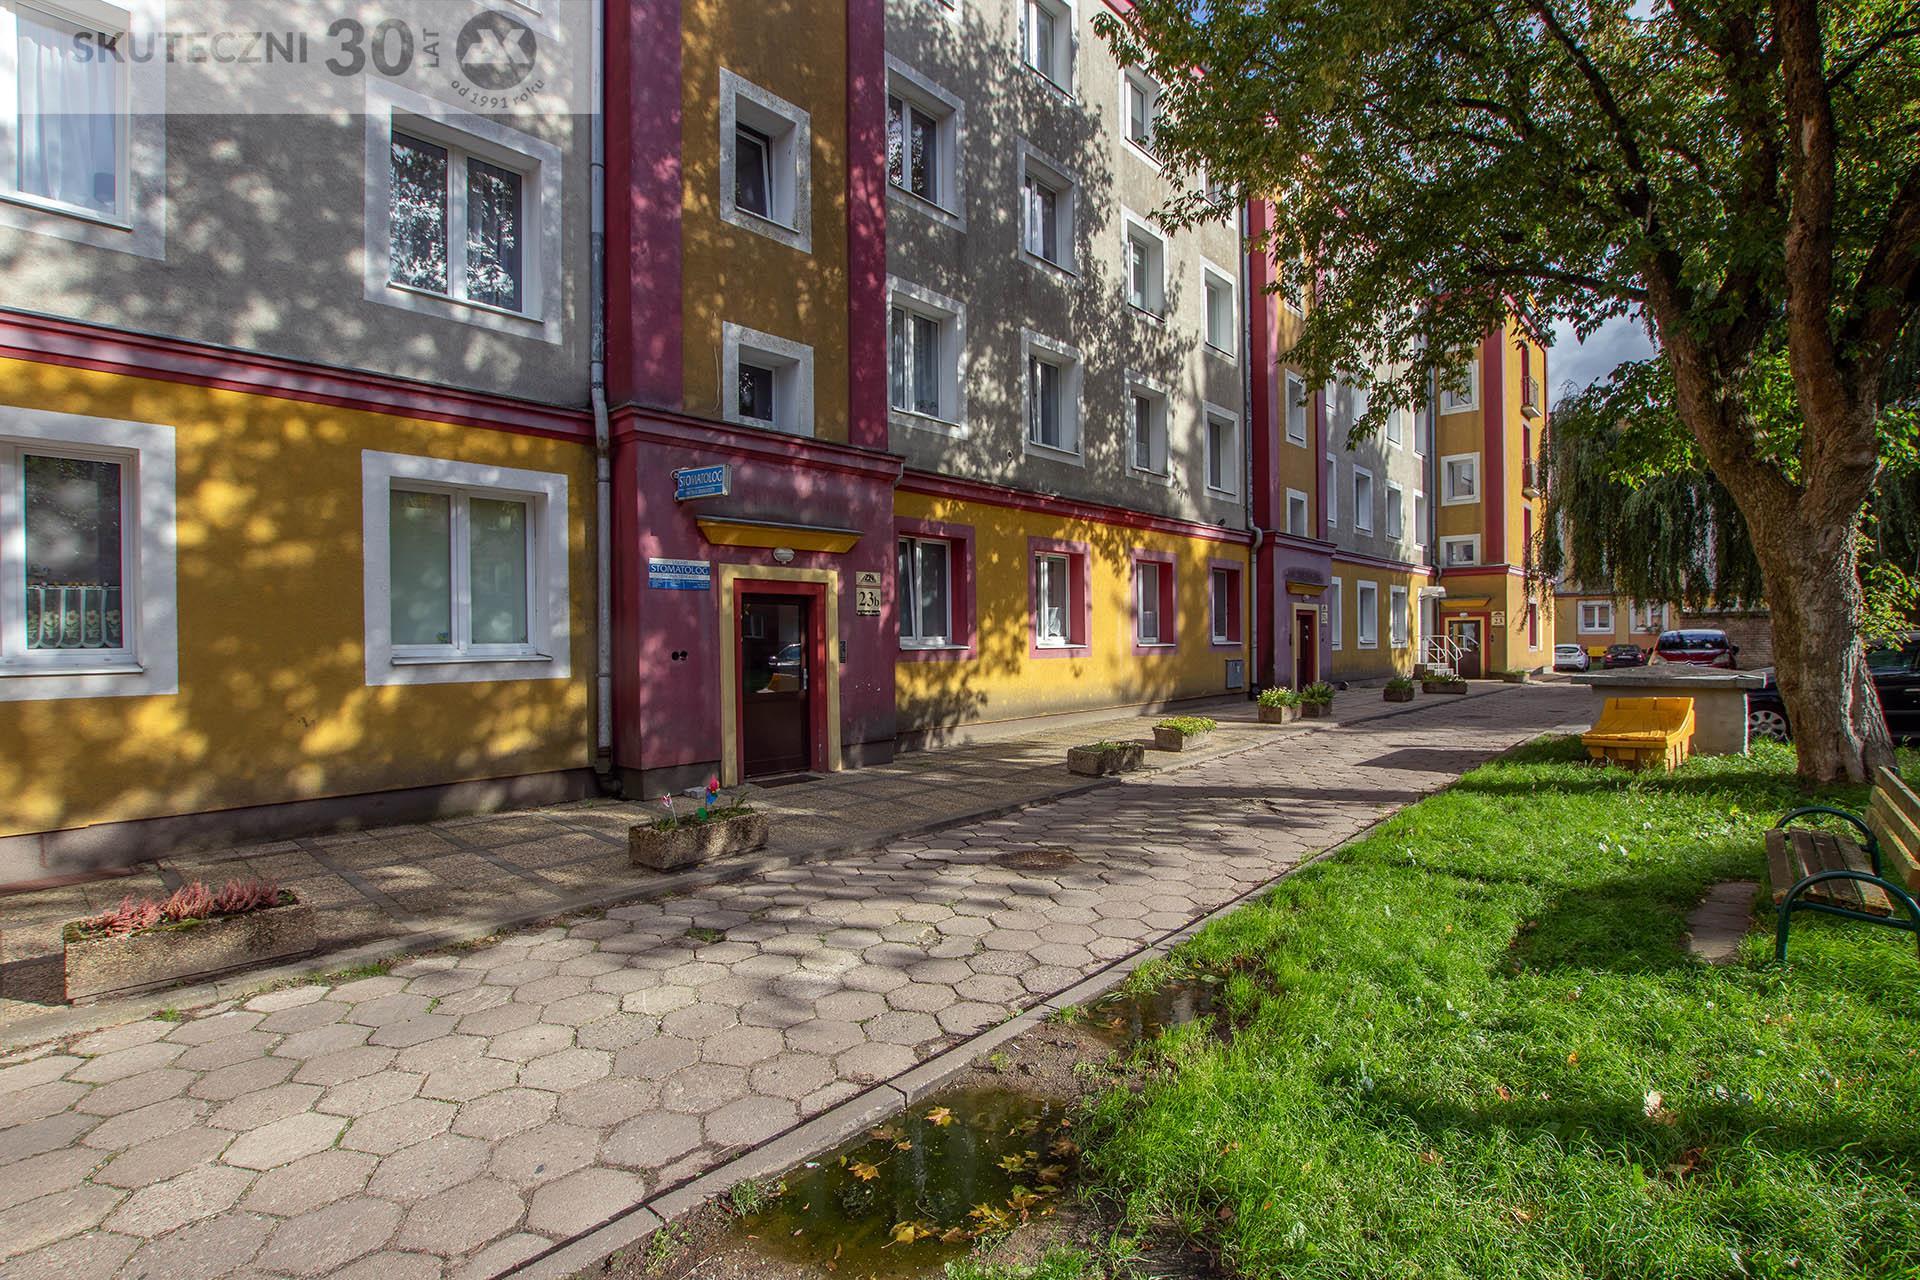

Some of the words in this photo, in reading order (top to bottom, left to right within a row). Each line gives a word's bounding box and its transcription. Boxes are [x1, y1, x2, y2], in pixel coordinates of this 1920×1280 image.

[679, 470, 722, 488] STOMATOLOG
[650, 564, 709, 575] STOMATOLOG
[858, 591, 880, 607] 23b
